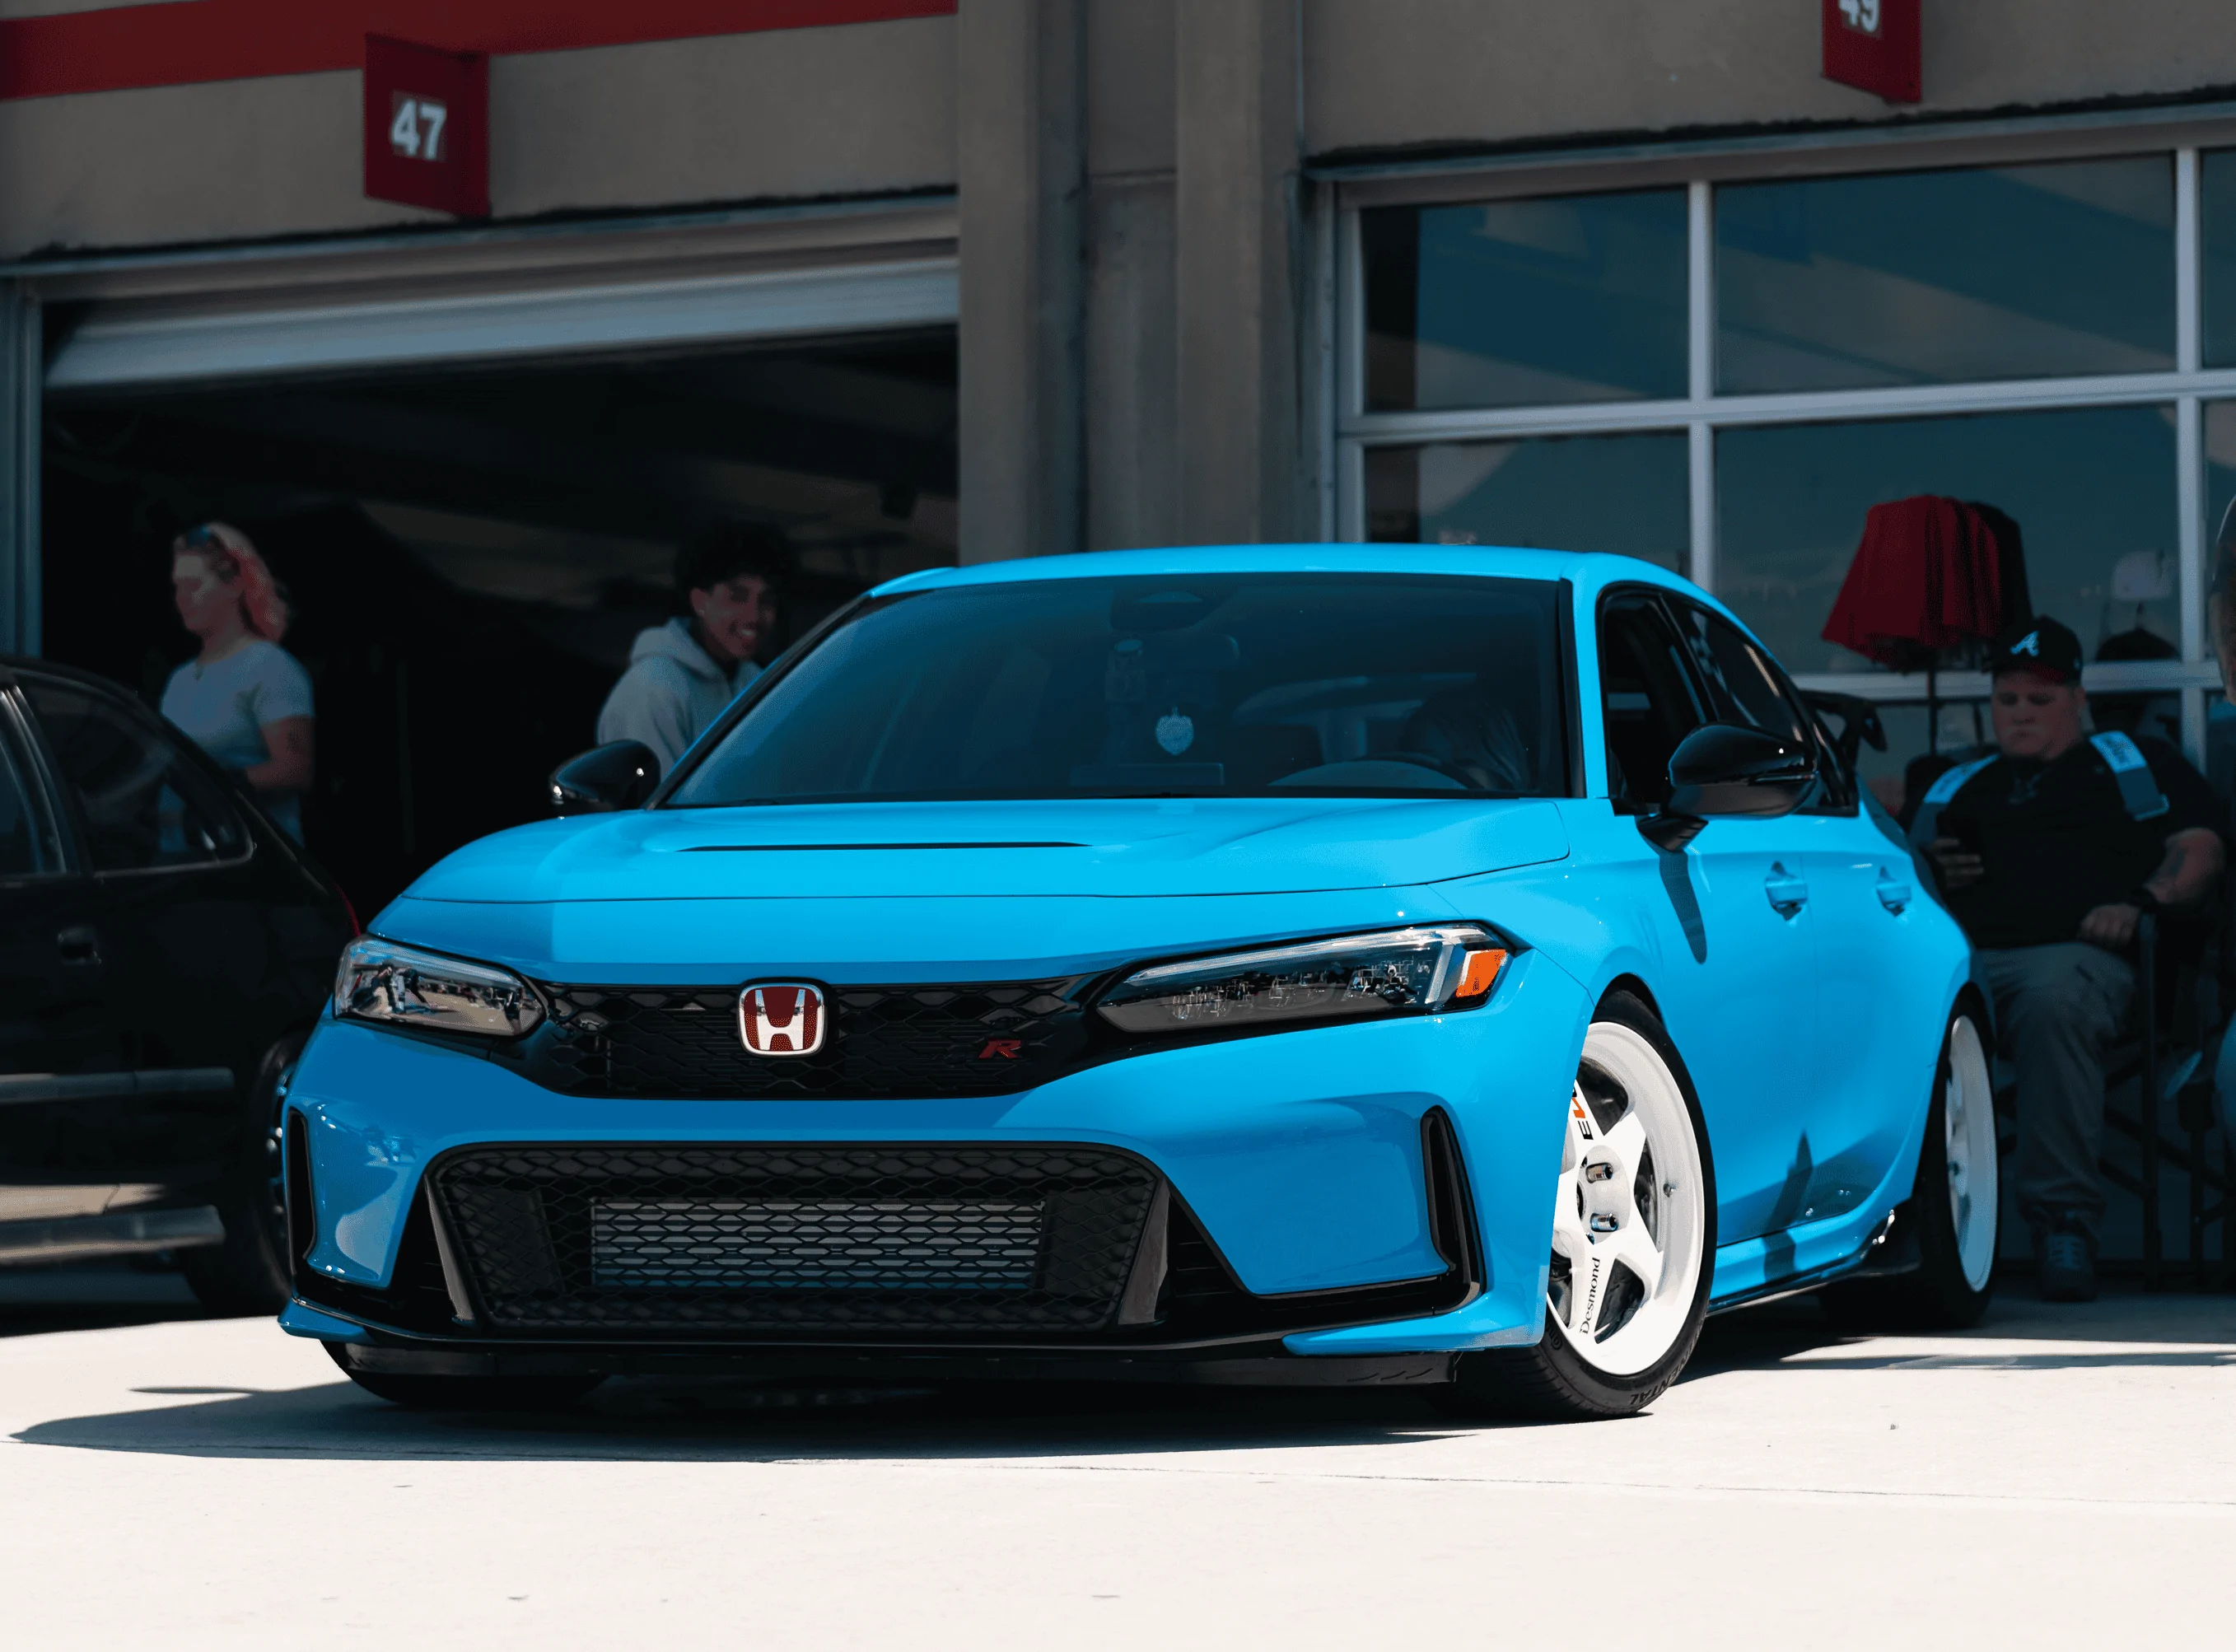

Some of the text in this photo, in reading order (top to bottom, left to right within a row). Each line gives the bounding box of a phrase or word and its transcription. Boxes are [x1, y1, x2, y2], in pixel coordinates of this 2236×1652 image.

[391, 99, 446, 161] 47
[2010, 631, 2039, 656] A
[755, 989, 806, 1050] H
[978, 1038, 1022, 1059] R
[1580, 1257, 1600, 1333] Desmond
